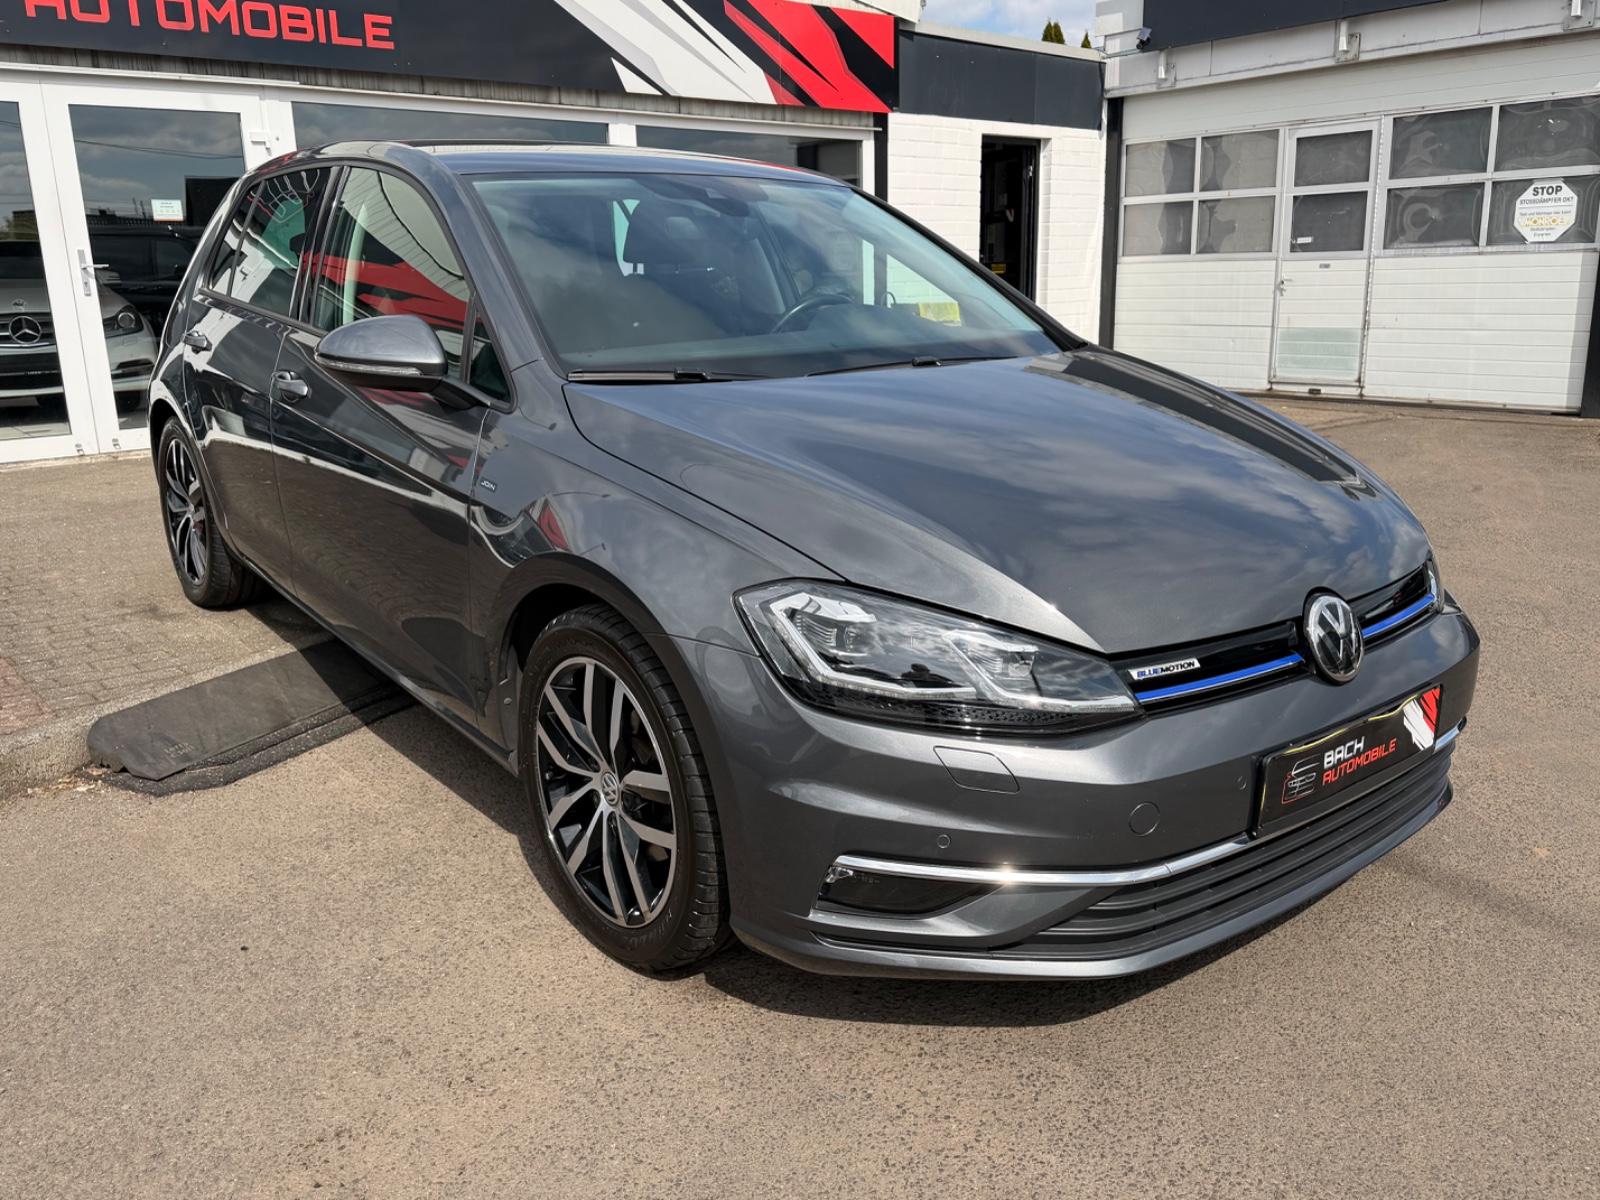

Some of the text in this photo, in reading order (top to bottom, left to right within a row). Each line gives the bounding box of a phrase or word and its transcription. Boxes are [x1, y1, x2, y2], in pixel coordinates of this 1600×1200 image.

[1532, 185, 1562, 196] STOP
[1136, 660, 1195, 678] BLUEMOTION
[1322, 738, 1397, 786] AUTOMOBILE
[1323, 736, 1365, 769] BACH
